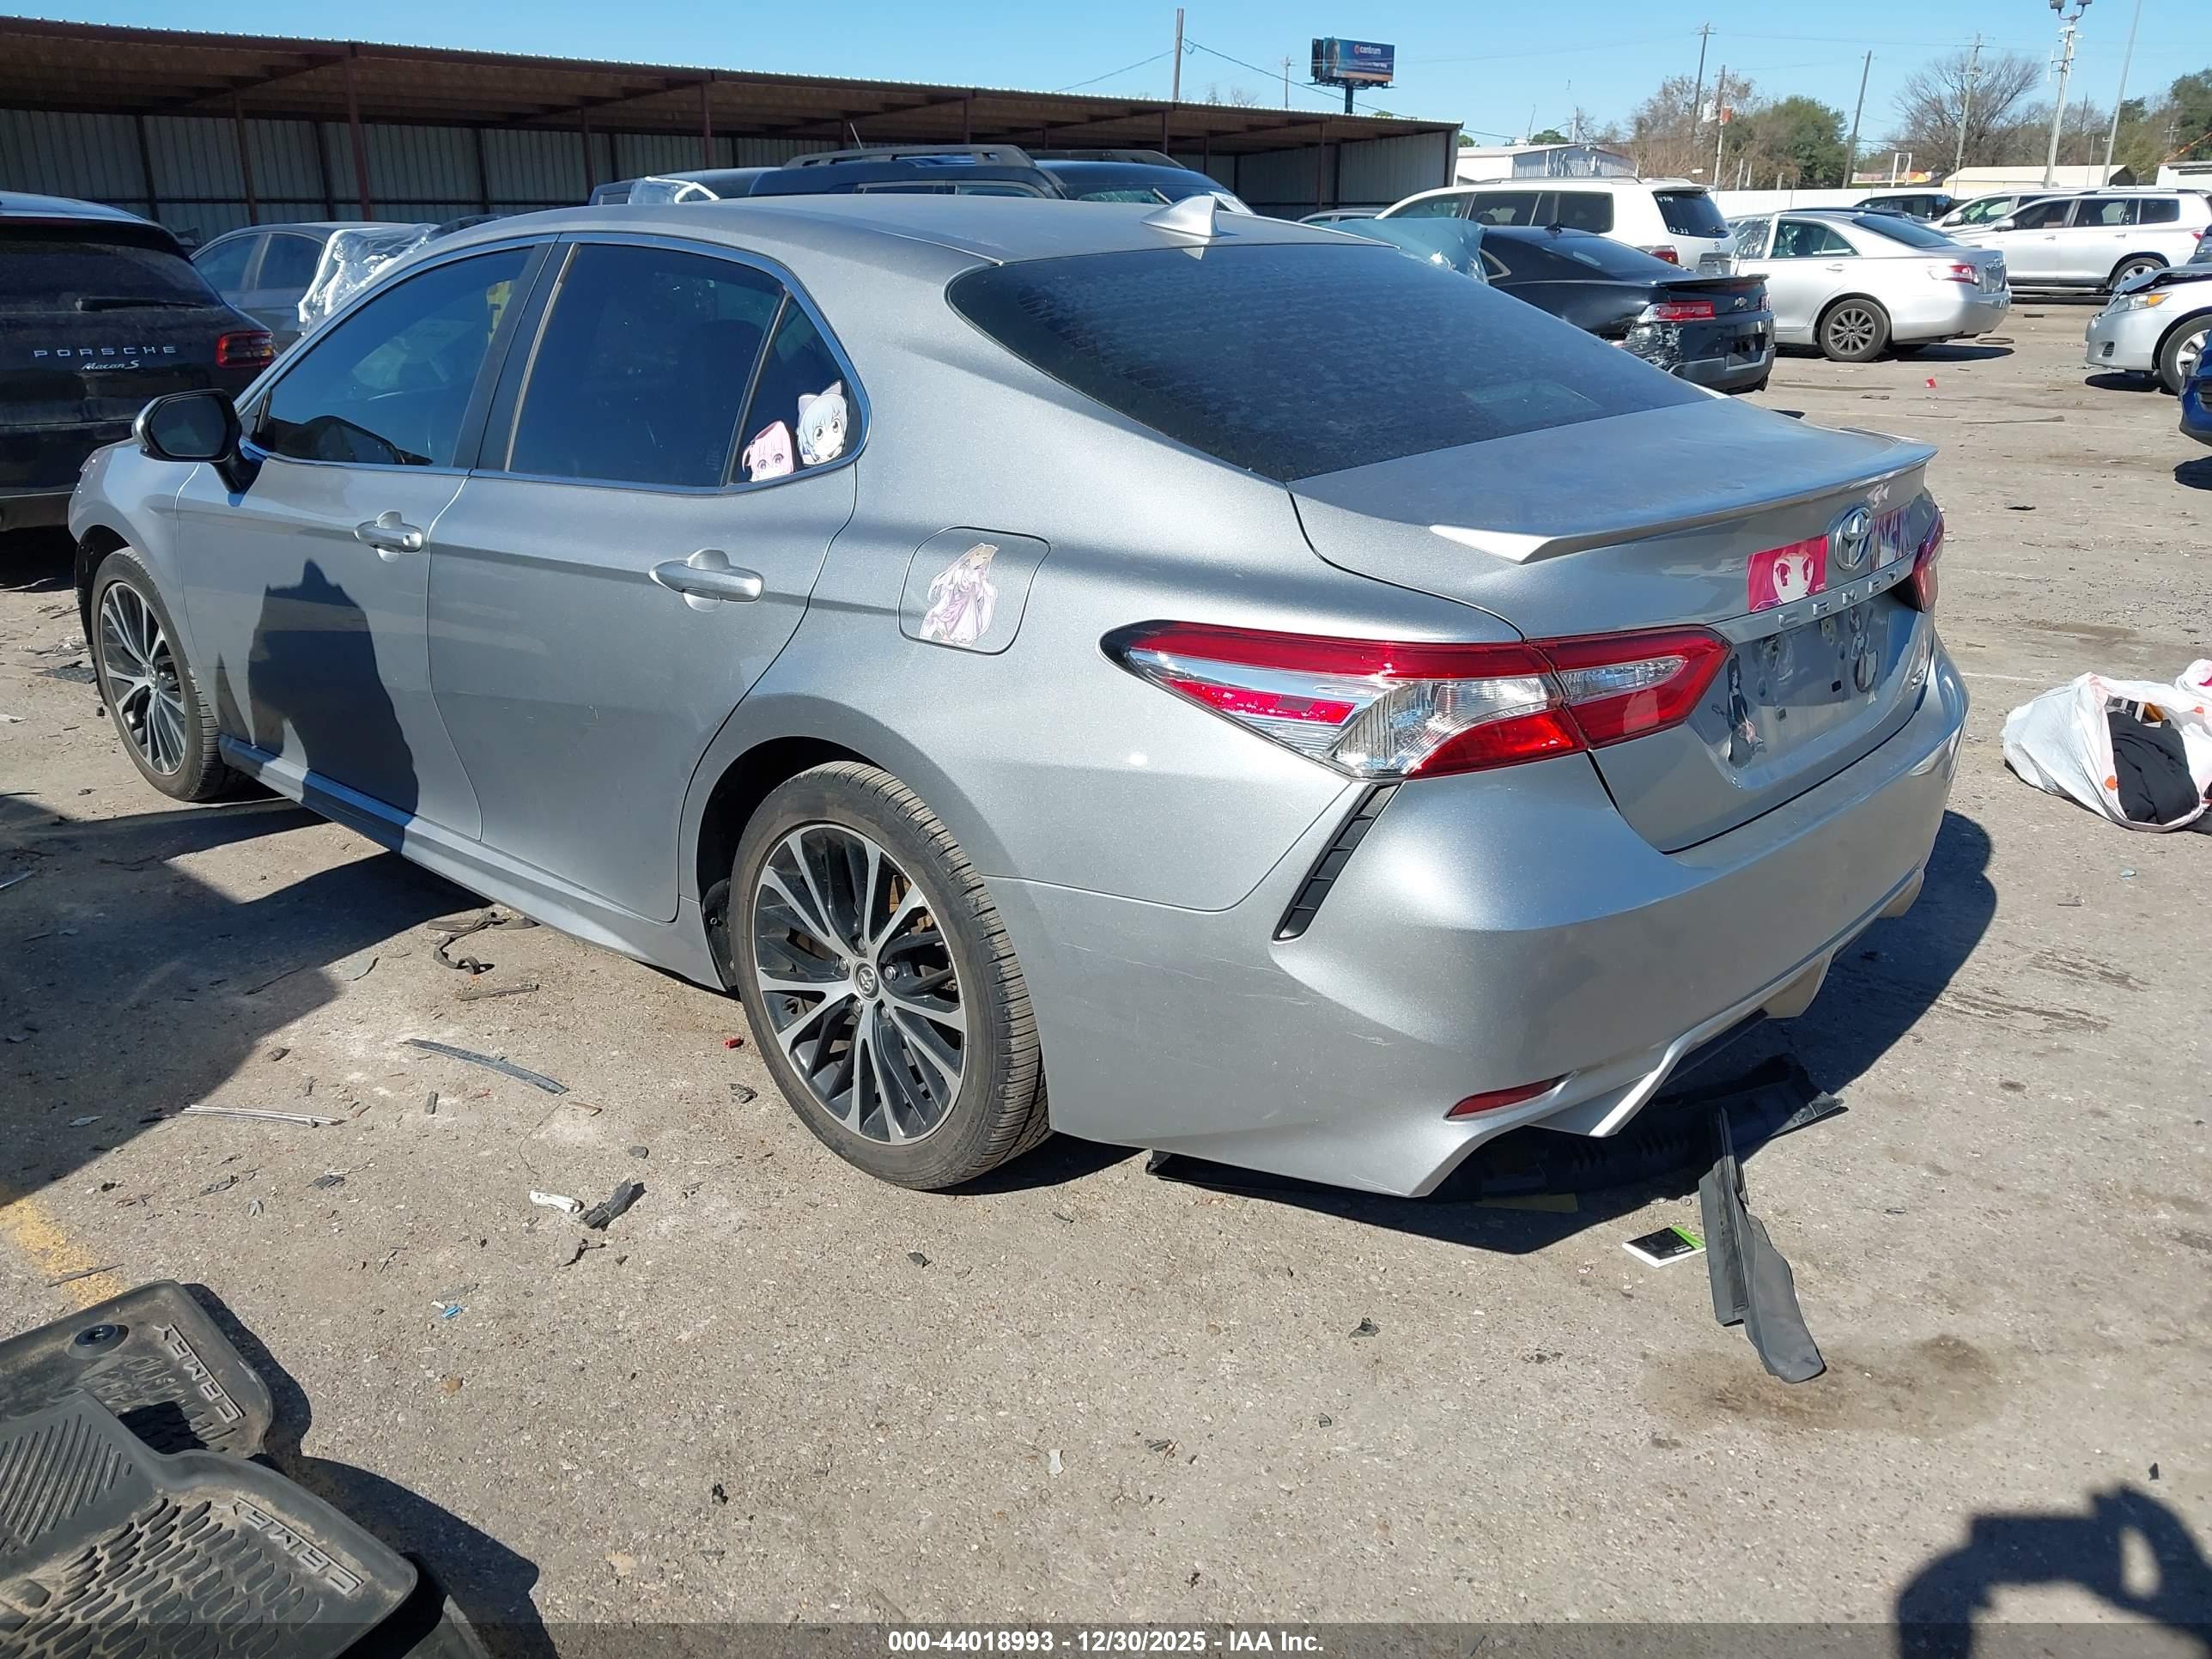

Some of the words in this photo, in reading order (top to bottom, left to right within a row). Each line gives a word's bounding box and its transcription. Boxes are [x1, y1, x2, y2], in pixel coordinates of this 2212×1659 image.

[33, 345, 177, 358] PORSCHE
[81, 362, 125, 371] Macan
[125, 359, 140, 370] S
[1778, 568, 1897, 629] CAMRY
[152, 1323, 244, 1424] CAMRY
[215, 1497, 362, 1595] CAMRY
